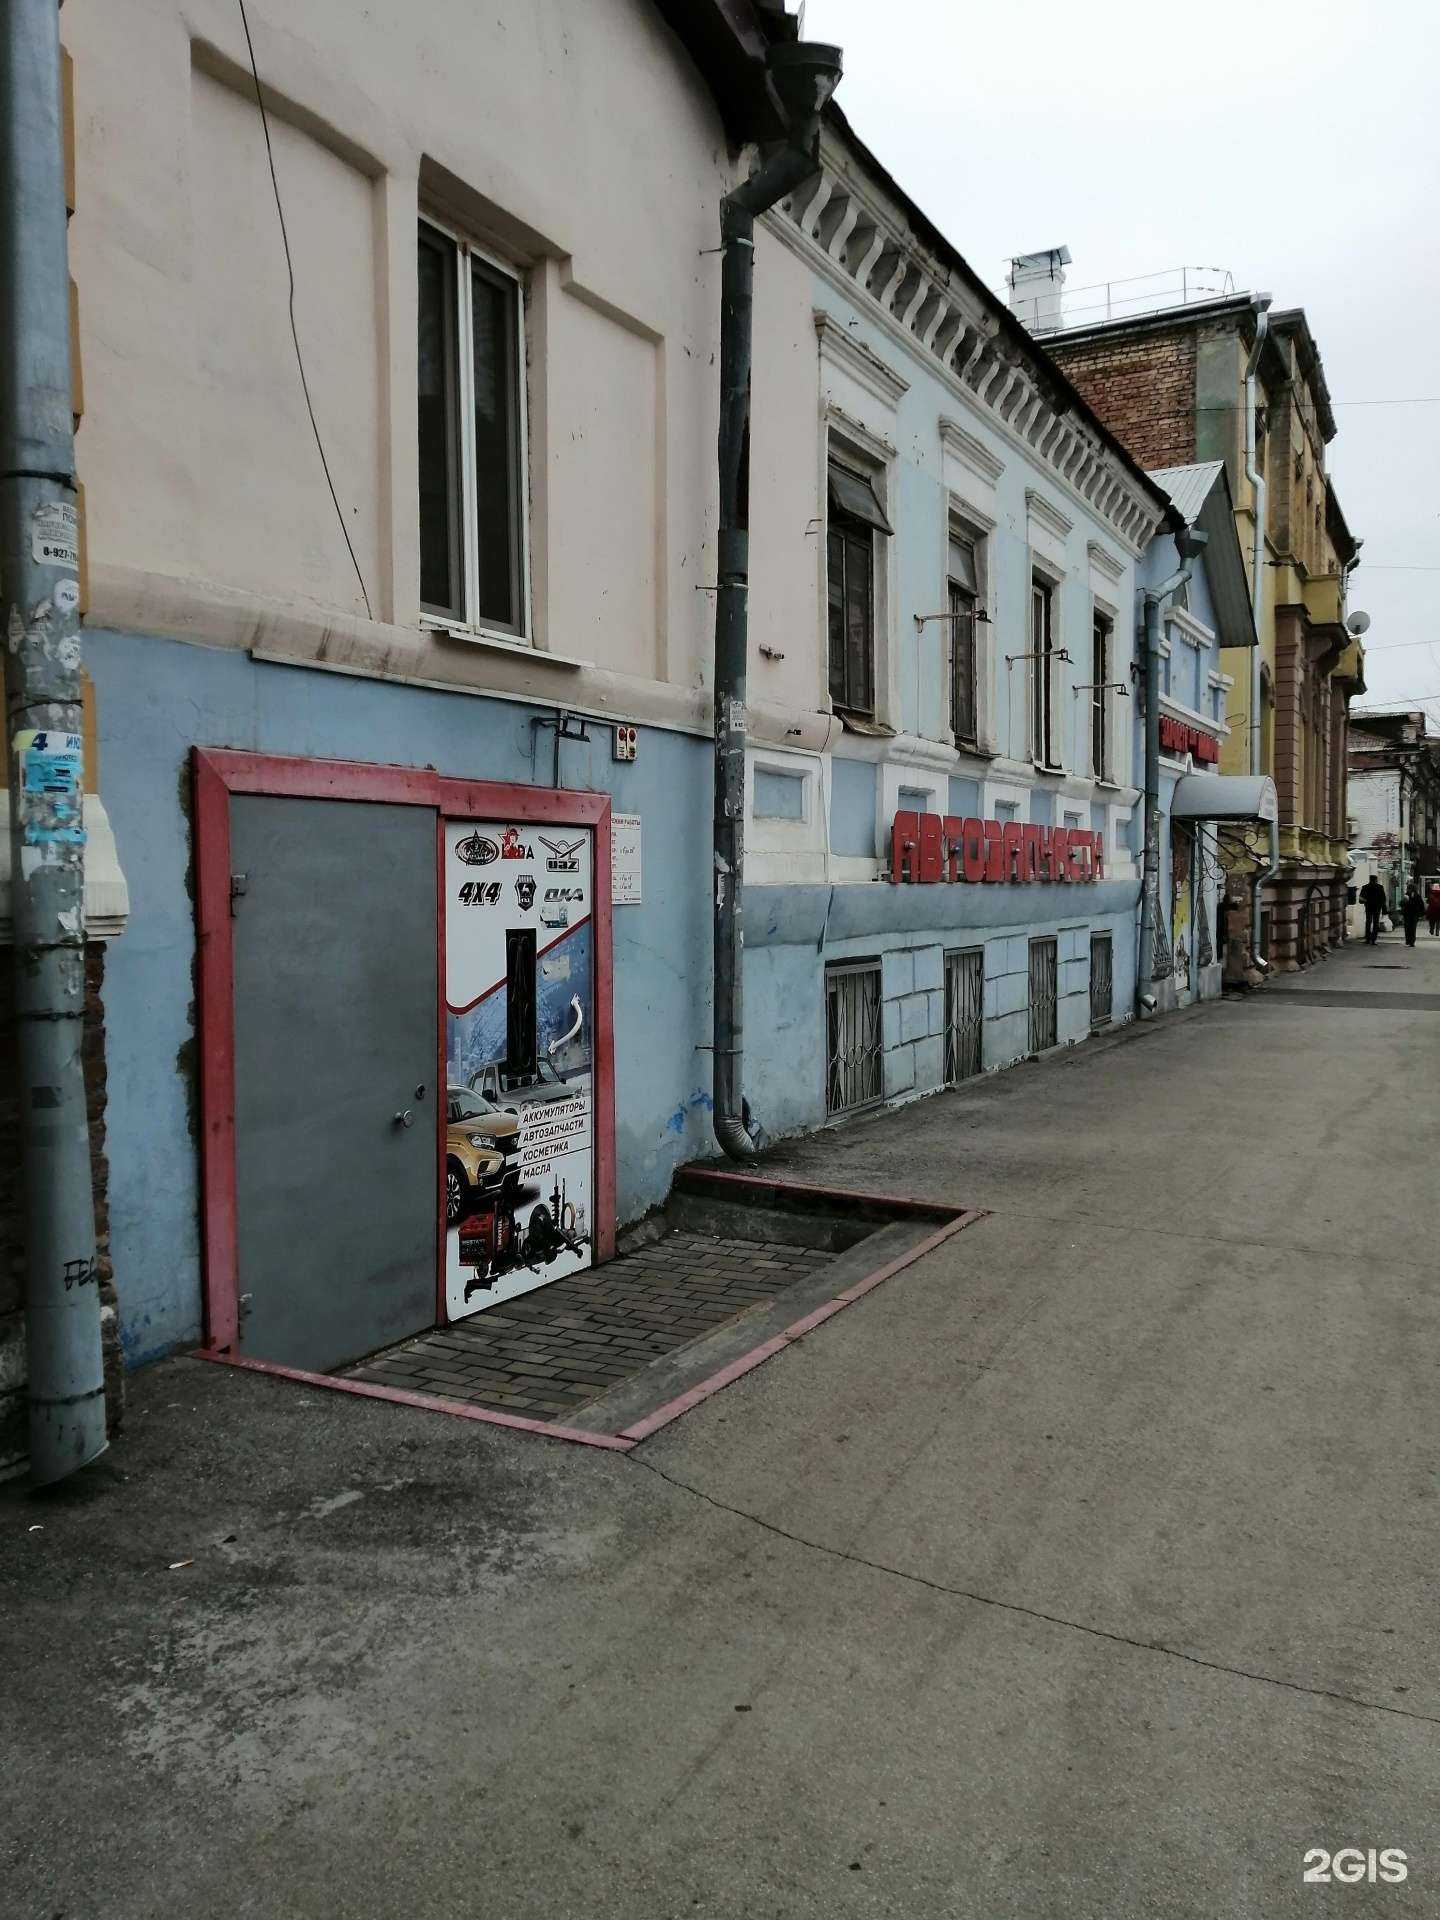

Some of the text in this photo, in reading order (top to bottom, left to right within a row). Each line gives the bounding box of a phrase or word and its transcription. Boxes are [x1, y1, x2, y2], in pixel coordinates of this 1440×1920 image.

[522, 1100, 586, 1124] АККУМУЛЯТОРЫ
[522, 1118, 584, 1143] АВТОЗАПЧАСТИ
[522, 1140, 570, 1162] КОСМЕТИКА
[523, 1163, 552, 1180] МАСЛА
